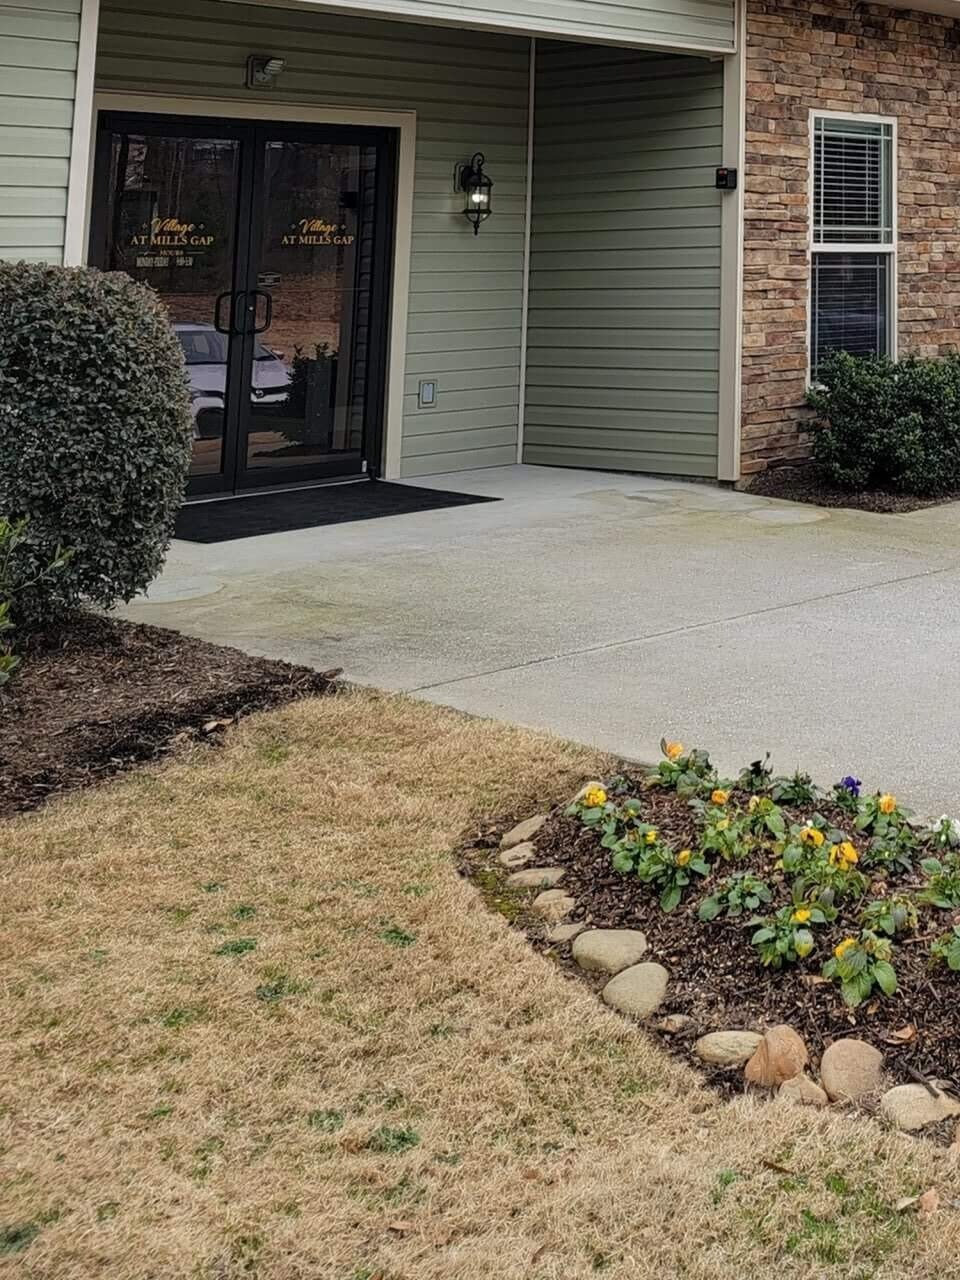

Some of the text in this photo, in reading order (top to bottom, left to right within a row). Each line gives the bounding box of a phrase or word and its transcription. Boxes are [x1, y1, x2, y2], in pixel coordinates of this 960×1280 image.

[150, 217, 194, 237] Village
[298, 218, 337, 236] Village
[130, 235, 214, 246] AT MILLS GAP
[281, 235, 354, 245] AT MILLS GAP
